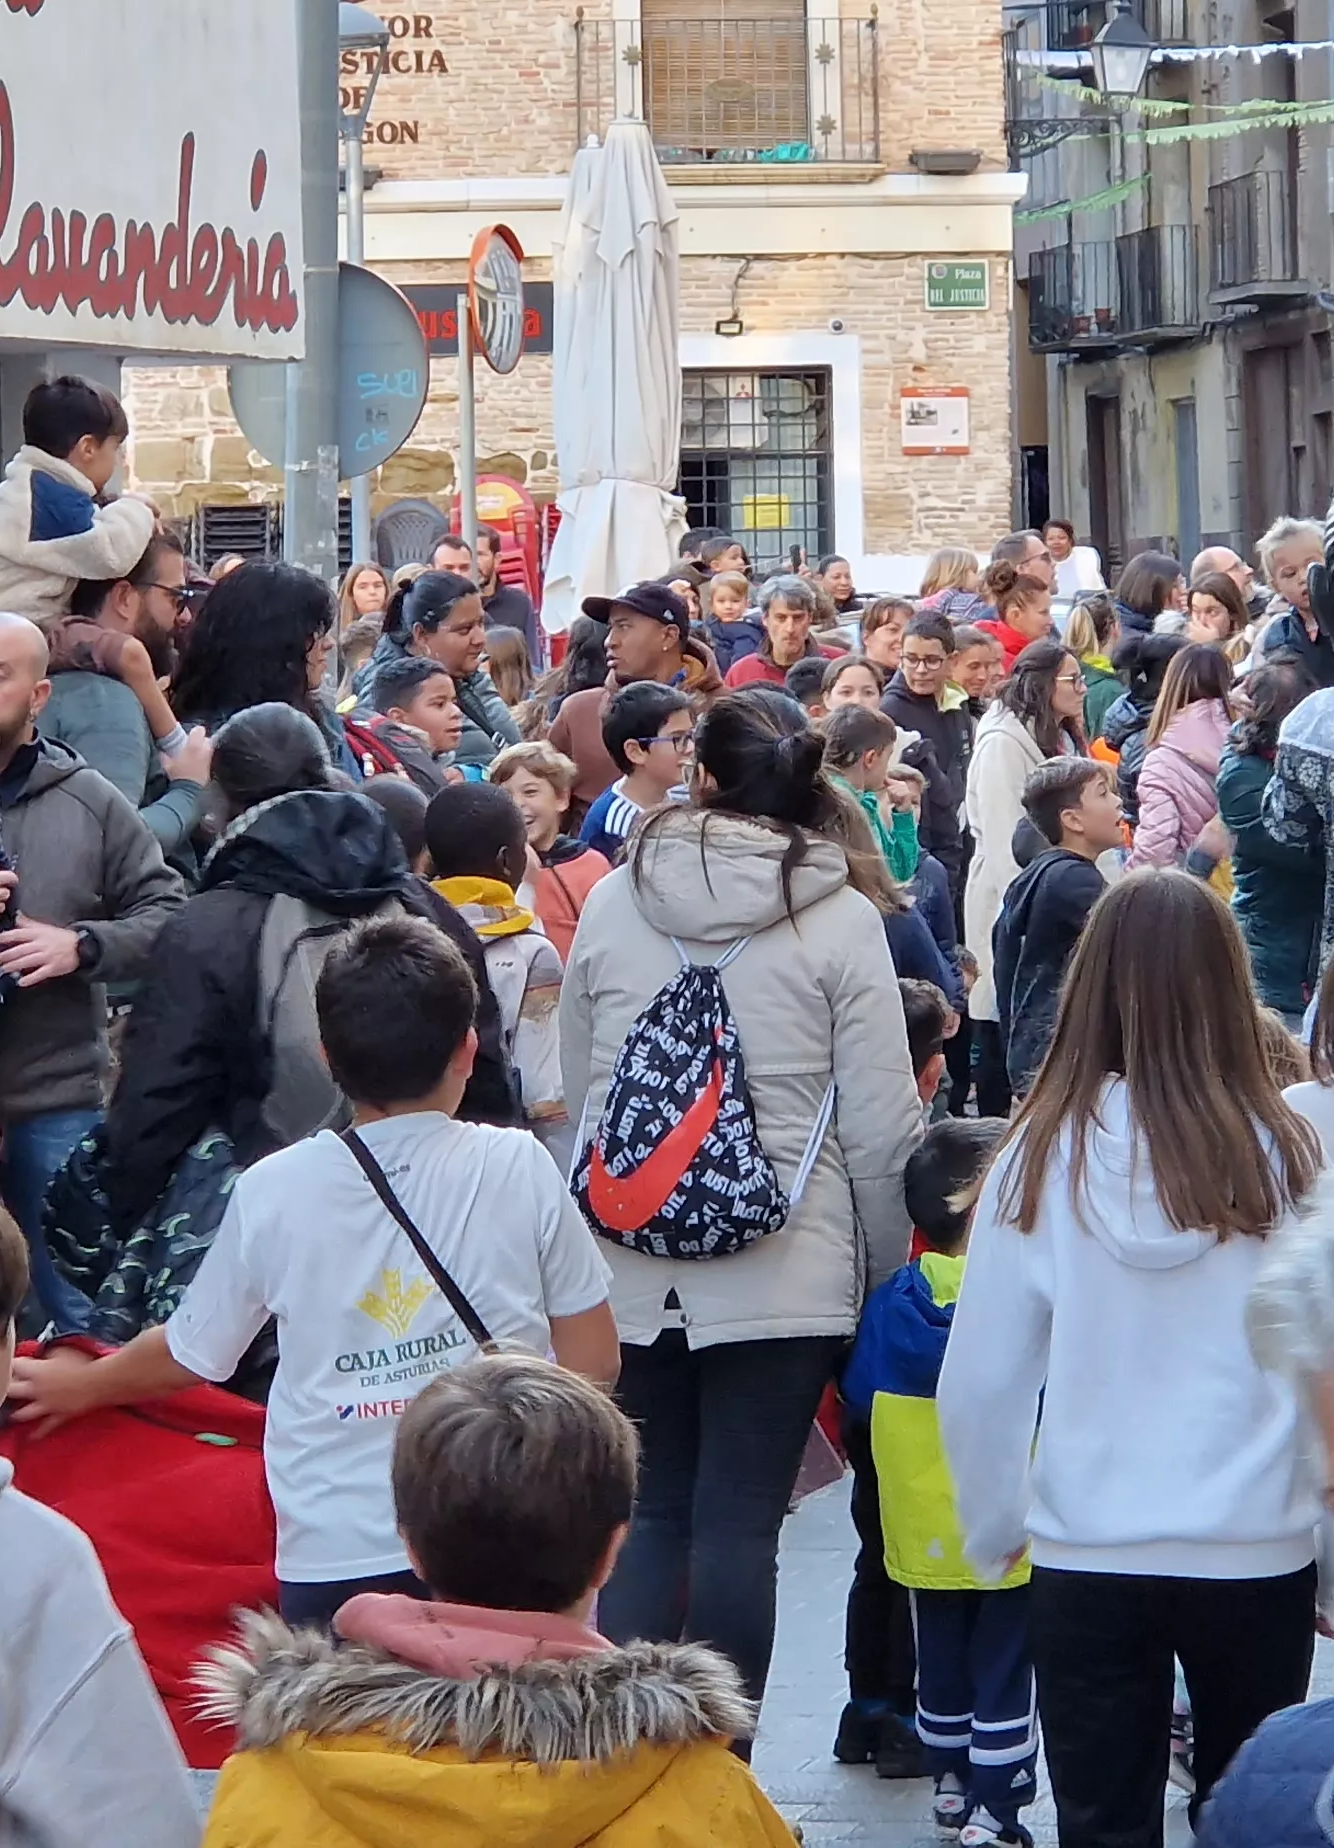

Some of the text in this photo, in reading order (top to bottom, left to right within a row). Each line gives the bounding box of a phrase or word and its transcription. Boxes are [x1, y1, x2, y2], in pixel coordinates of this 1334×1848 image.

[379, 15, 433, 38] OR
[359, 121, 419, 145] GON
[954, 268, 982, 280] Plaza
[930, 288, 985, 303] DEL JUSTICIA
[334, 1329, 467, 1374] CAJA RURAL
[360, 1357, 451, 1388] DE ASTURIAS
